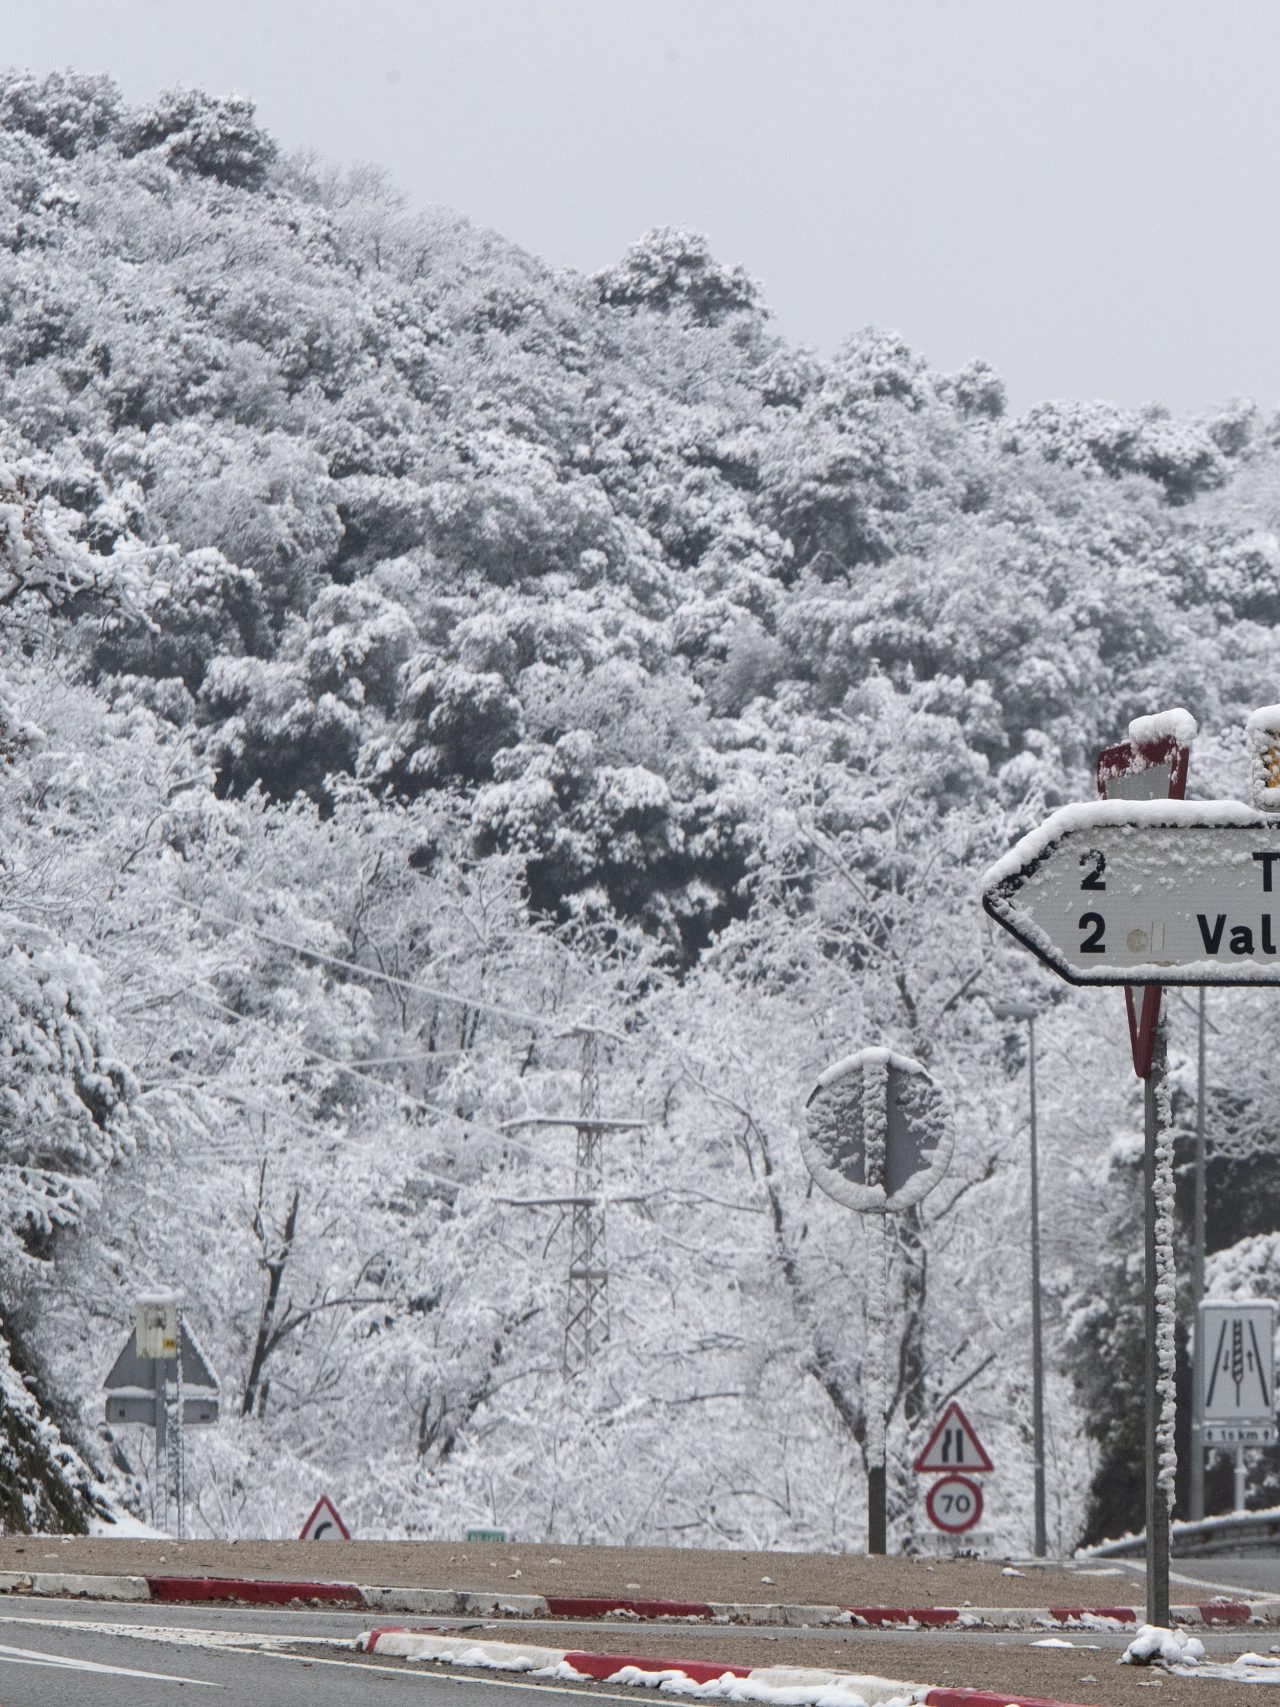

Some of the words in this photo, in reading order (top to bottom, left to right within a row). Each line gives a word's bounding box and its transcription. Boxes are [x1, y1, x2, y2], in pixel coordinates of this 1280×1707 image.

[1079, 849, 1106, 891] 2
[1079, 912, 1106, 953] 2
[1238, 1430, 1258, 1440] km
[941, 1494, 971, 1514] 70
